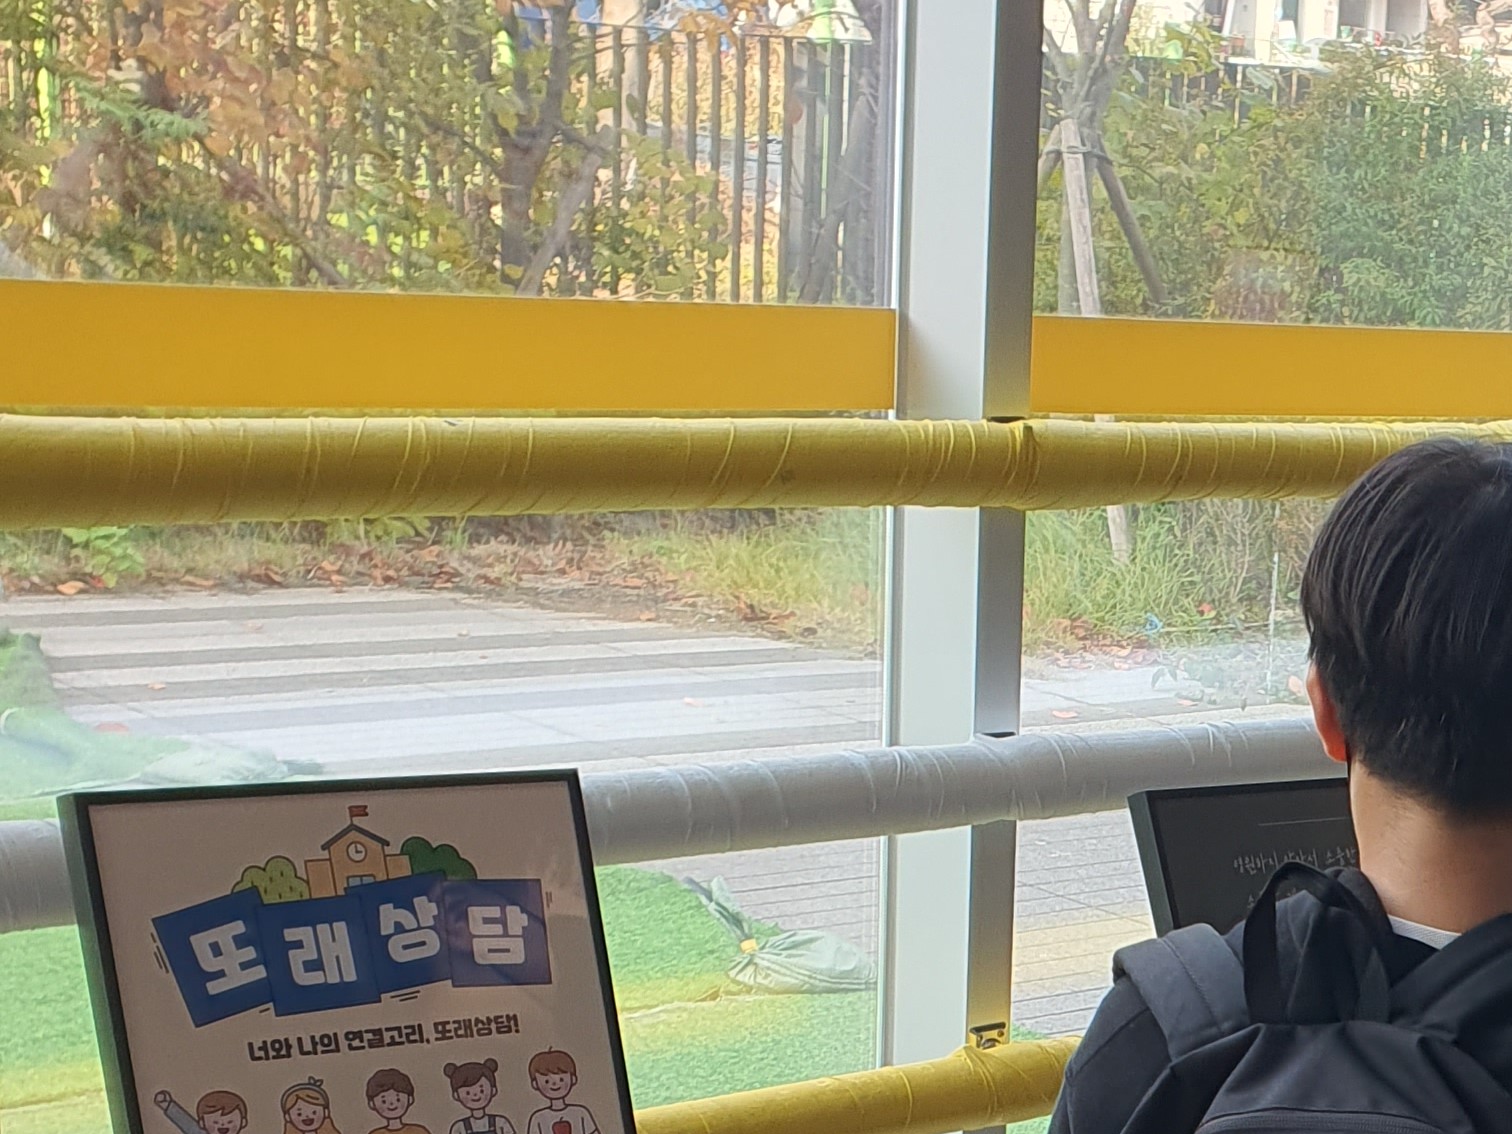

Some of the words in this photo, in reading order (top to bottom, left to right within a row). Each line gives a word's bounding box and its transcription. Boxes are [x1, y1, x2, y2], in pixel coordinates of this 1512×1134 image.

[189, 896, 529, 997] 또래상담
[247, 1037, 293, 1062] 너와
[297, 1032, 341, 1056] 나의
[344, 1023, 430, 1051] 연결고리,
[433, 1013, 520, 1042] 또래상담!
